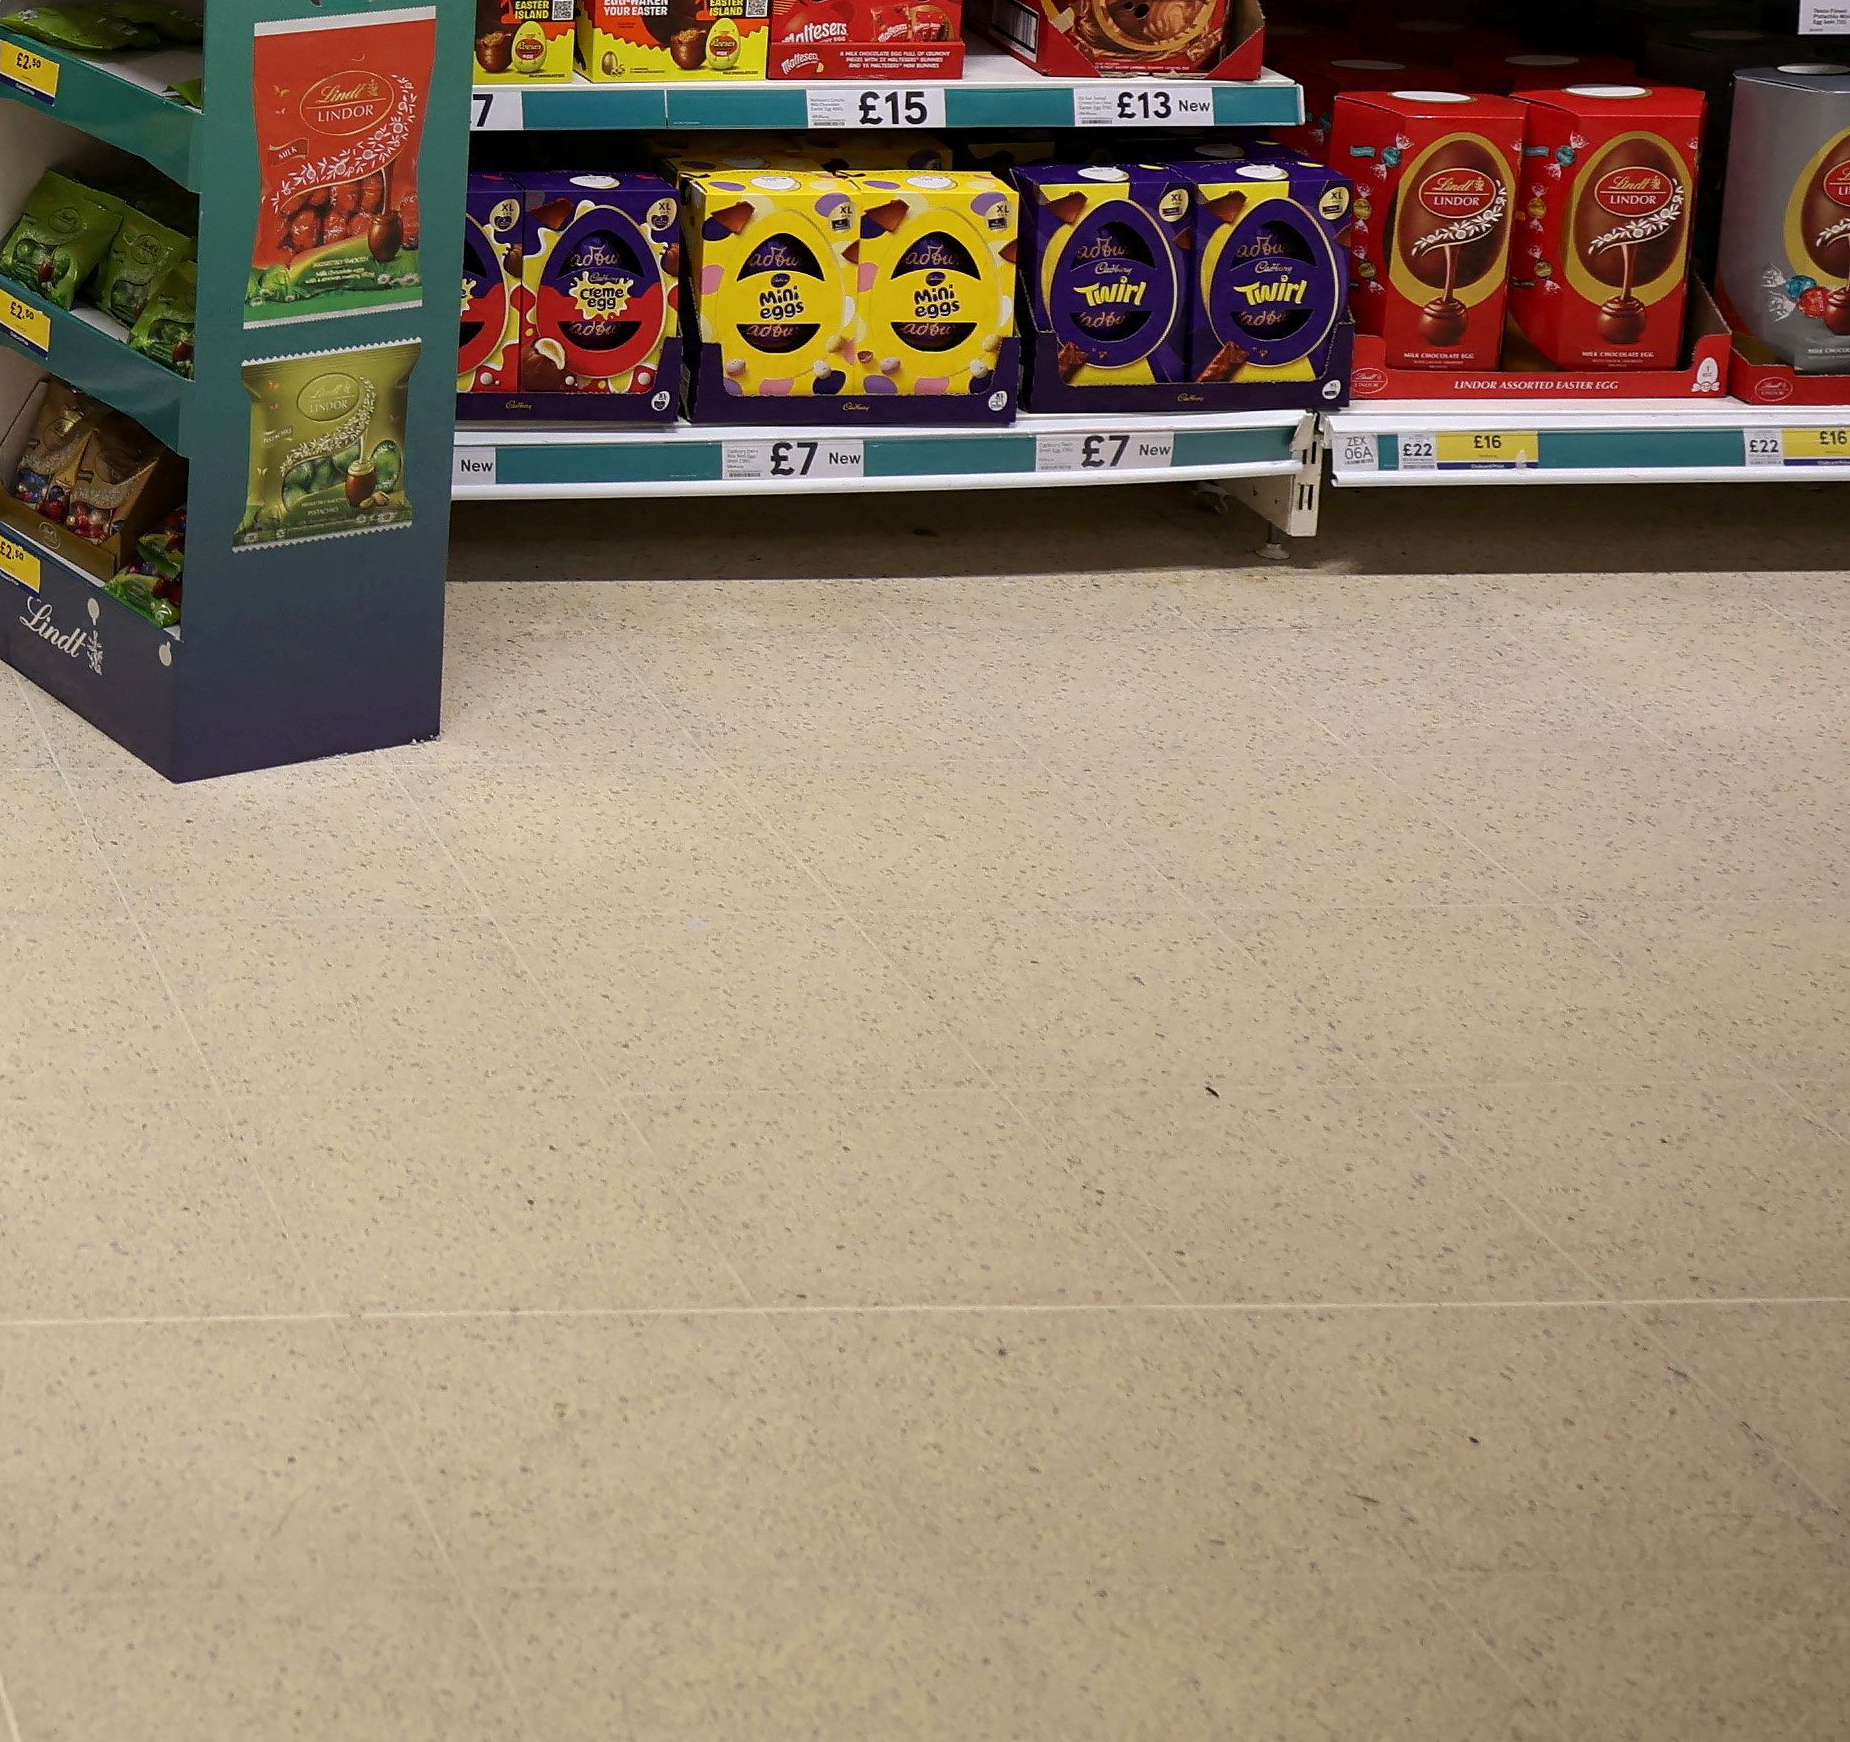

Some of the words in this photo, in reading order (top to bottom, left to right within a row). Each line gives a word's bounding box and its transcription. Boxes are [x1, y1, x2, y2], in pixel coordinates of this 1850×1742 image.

[603, 5, 630, 16] YOUR
[632, 5, 668, 16] EASTER
[317, 104, 374, 121] LINDOR
[858, 92, 927, 124] £15
[1454, 381, 1496, 390] LINDOR
[1498, 381, 1552, 390] ASSORTED
[1555, 380, 1593, 389] EASTER
[1596, 380, 1618, 389] EGG
[770, 442, 816, 476] £7
[828, 450, 860, 466] New
